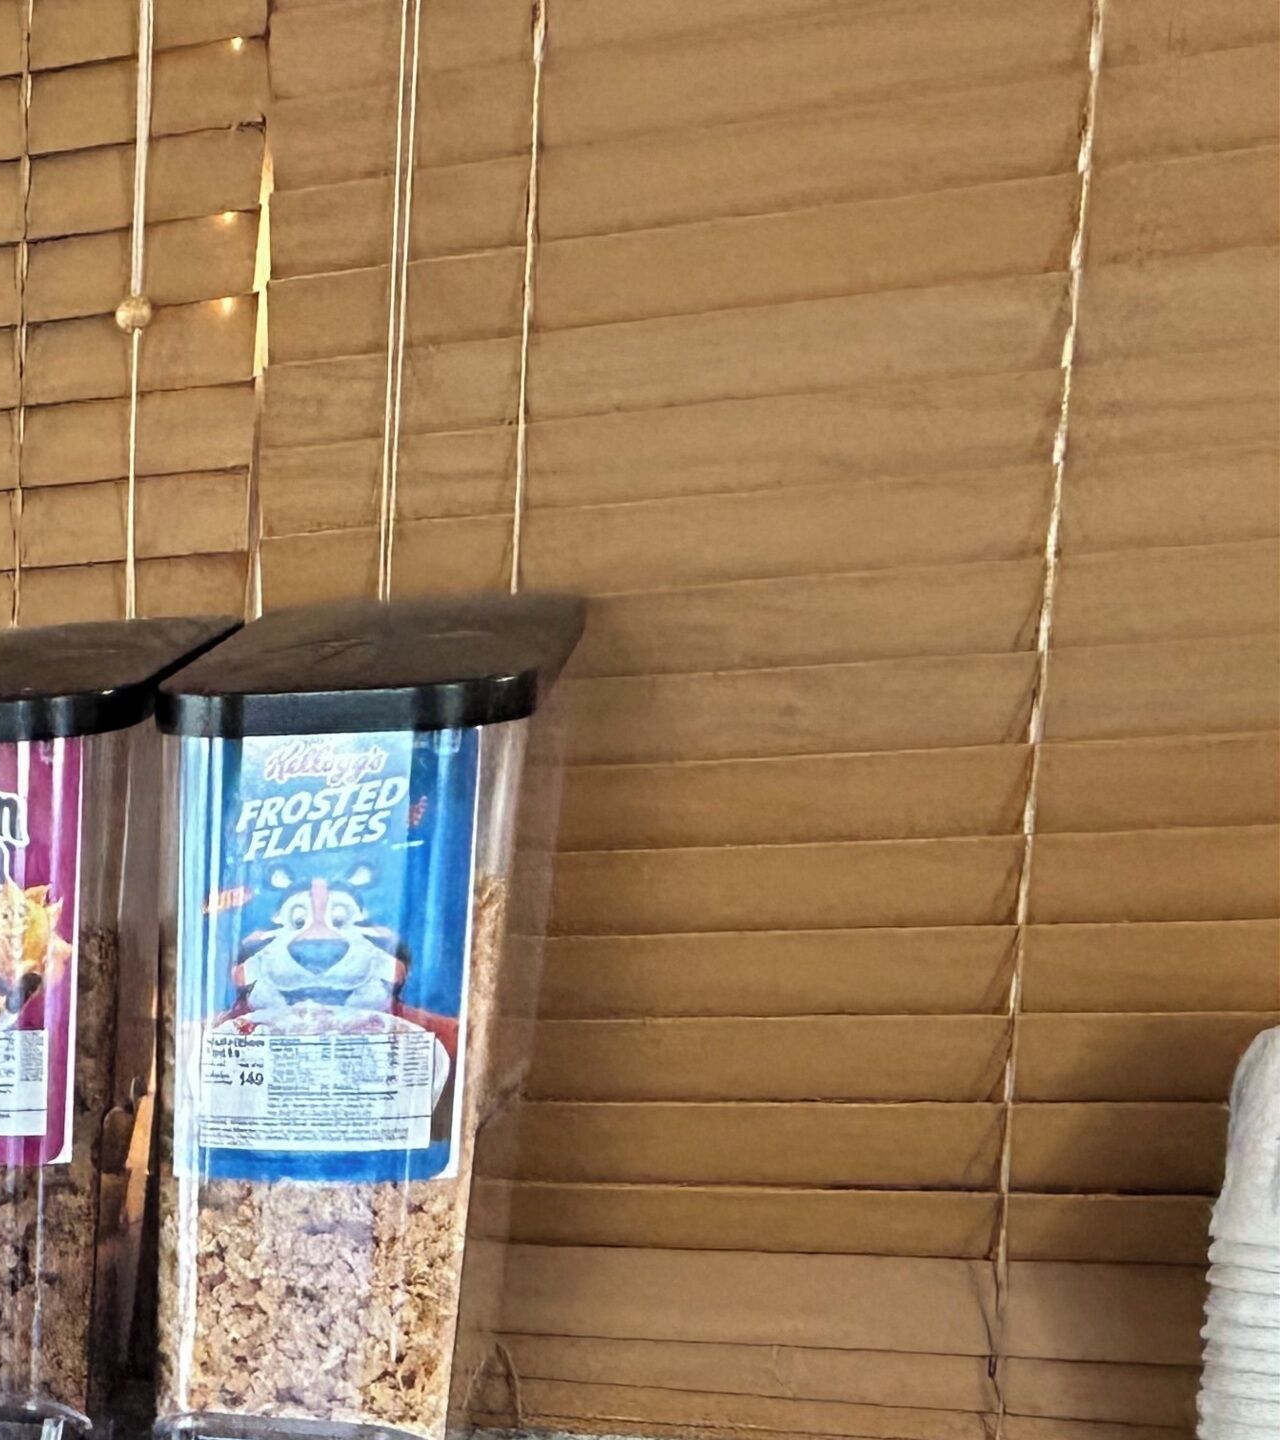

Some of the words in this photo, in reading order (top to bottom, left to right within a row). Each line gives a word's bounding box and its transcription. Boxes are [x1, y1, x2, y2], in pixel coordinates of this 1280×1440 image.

[264, 744, 387, 786] Kellogg's
[236, 776, 409, 832] FROSTED
[243, 811, 391, 862] FLAKES
